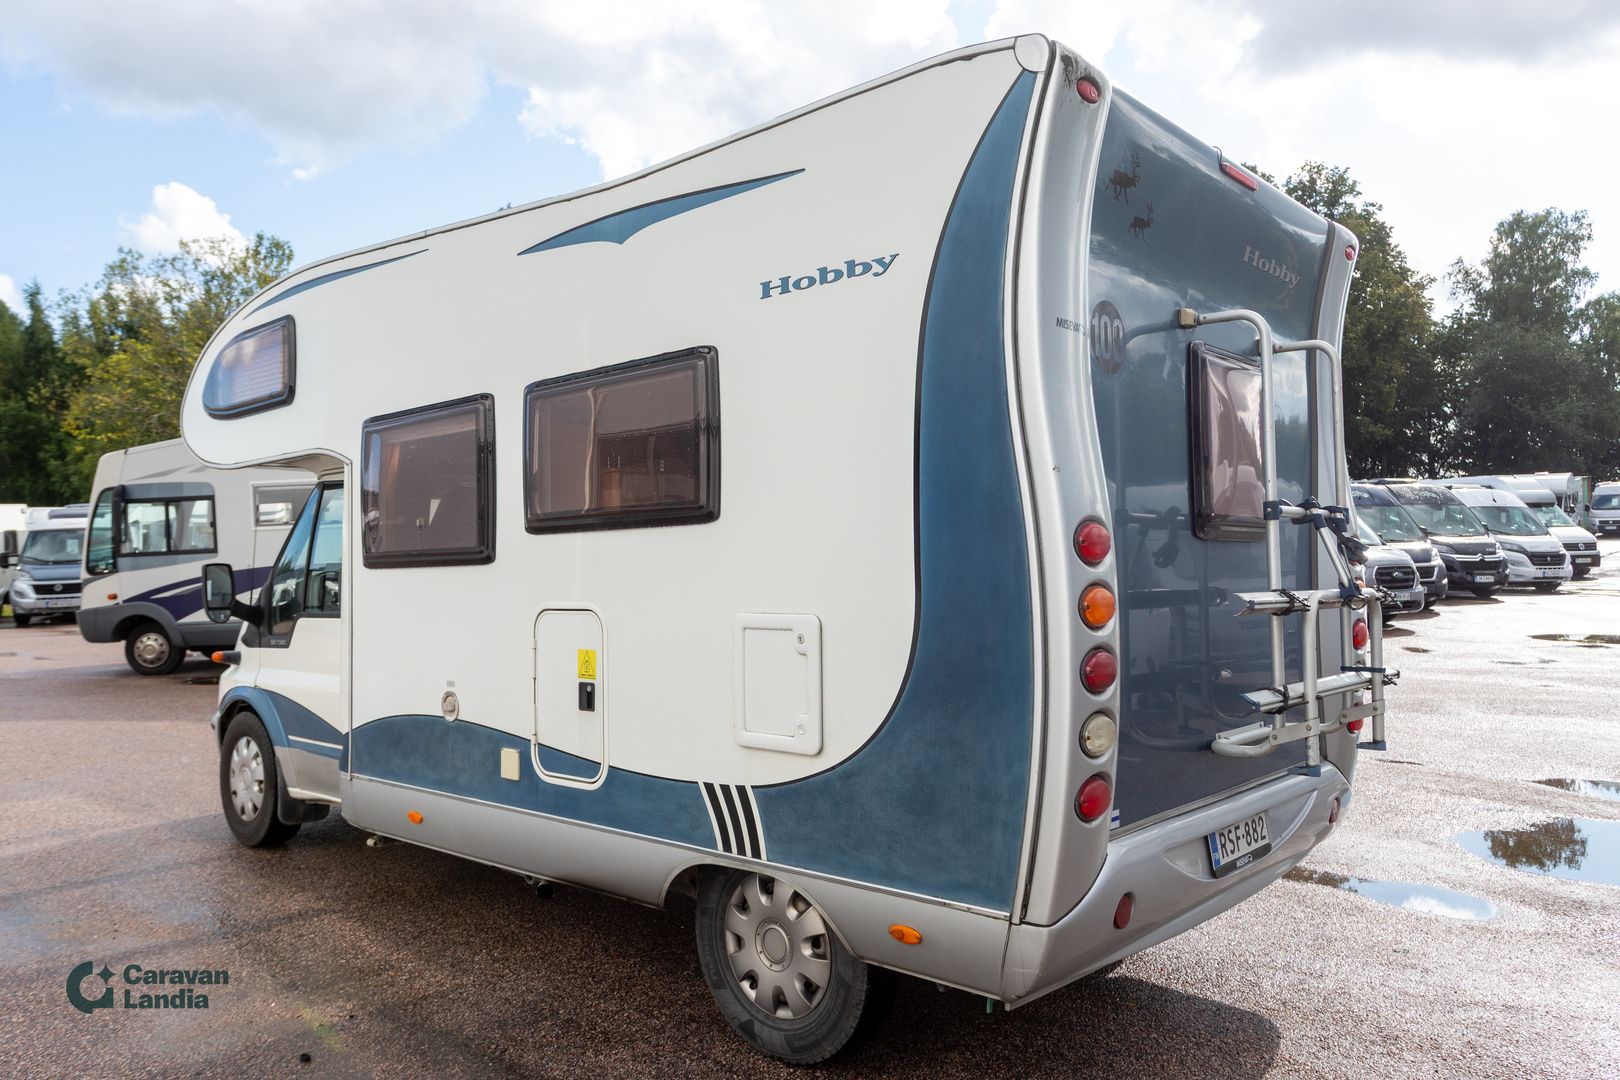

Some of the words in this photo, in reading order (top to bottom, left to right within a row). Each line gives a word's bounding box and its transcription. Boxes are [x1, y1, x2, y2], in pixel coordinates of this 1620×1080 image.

[759, 253, 900, 300] Hobby
[1242, 245, 1301, 289] Hobby
[1091, 312, 1124, 362] 100
[1219, 815, 1266, 859] RSF-882
